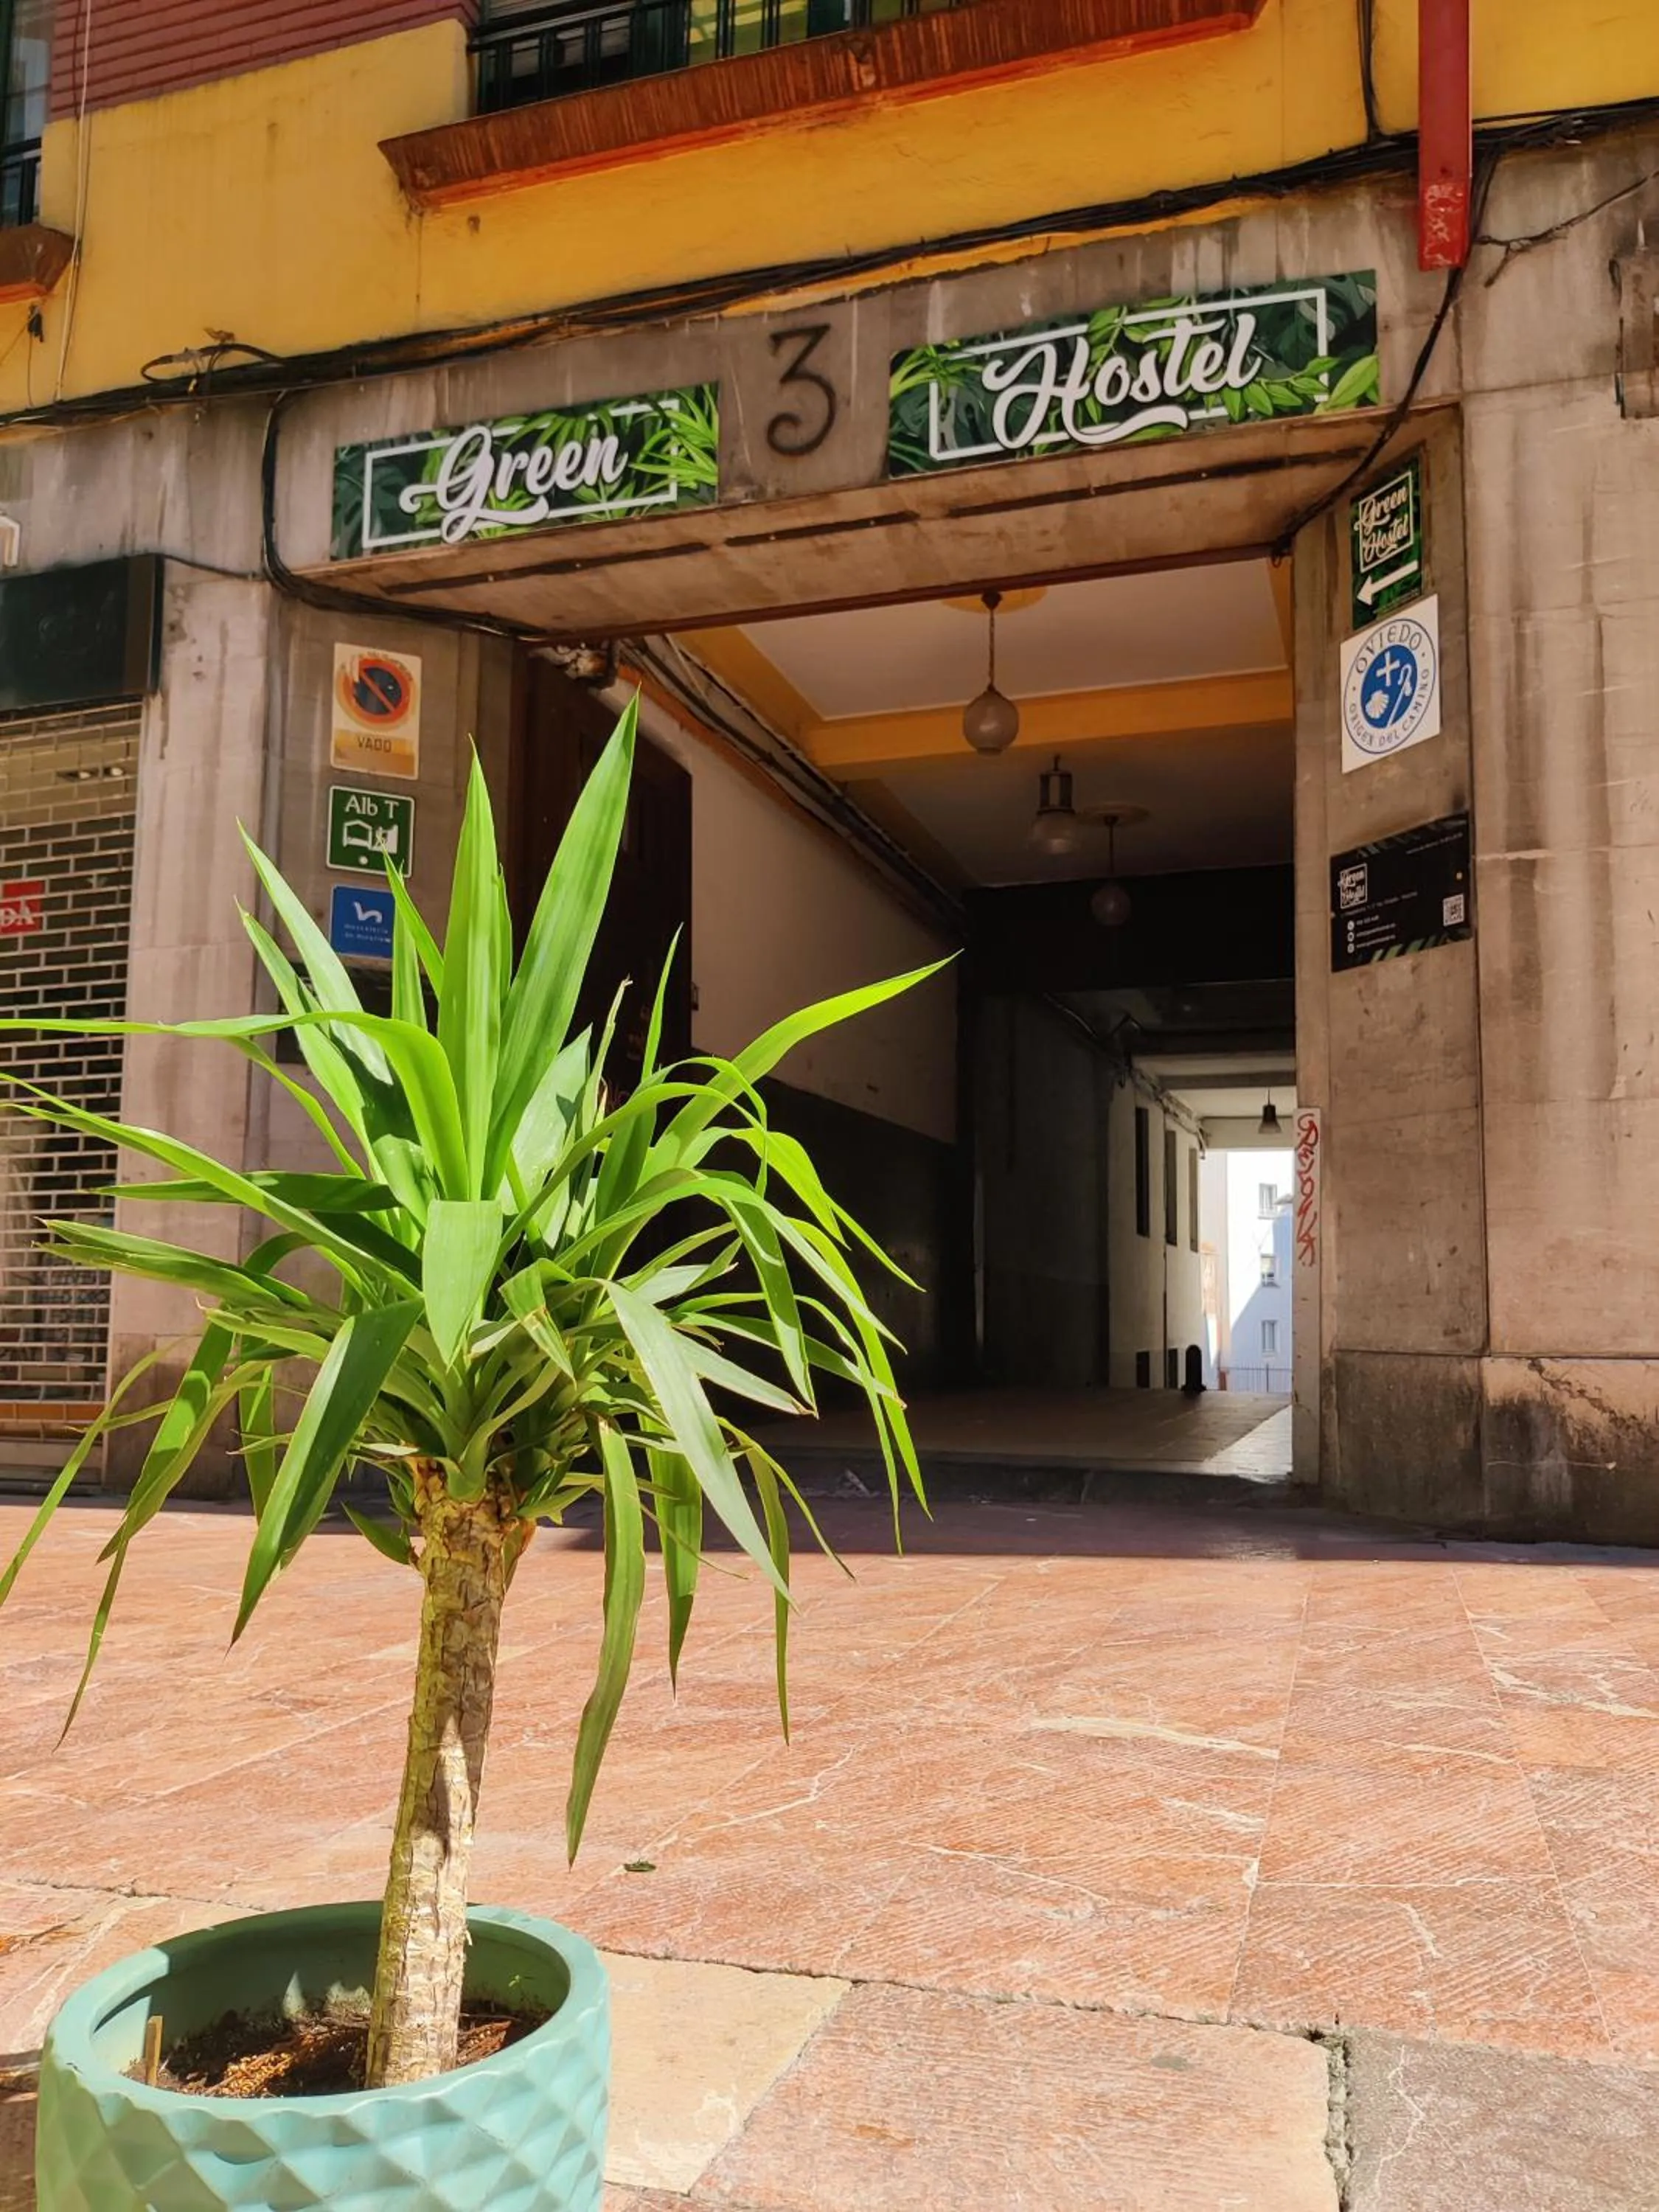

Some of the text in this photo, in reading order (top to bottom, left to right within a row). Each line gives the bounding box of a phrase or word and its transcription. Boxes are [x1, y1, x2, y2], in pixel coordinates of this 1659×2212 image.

[766, 321, 837, 457] 3
[981, 313, 1262, 449] Hostel
[399, 425, 630, 544] Green
[1354, 486, 1408, 535] Green
[1363, 513, 1408, 563] Hostel
[1355, 624, 1422, 675] OVIEDO
[358, 736, 392, 754] VADO
[344, 794, 400, 819] Alb T
